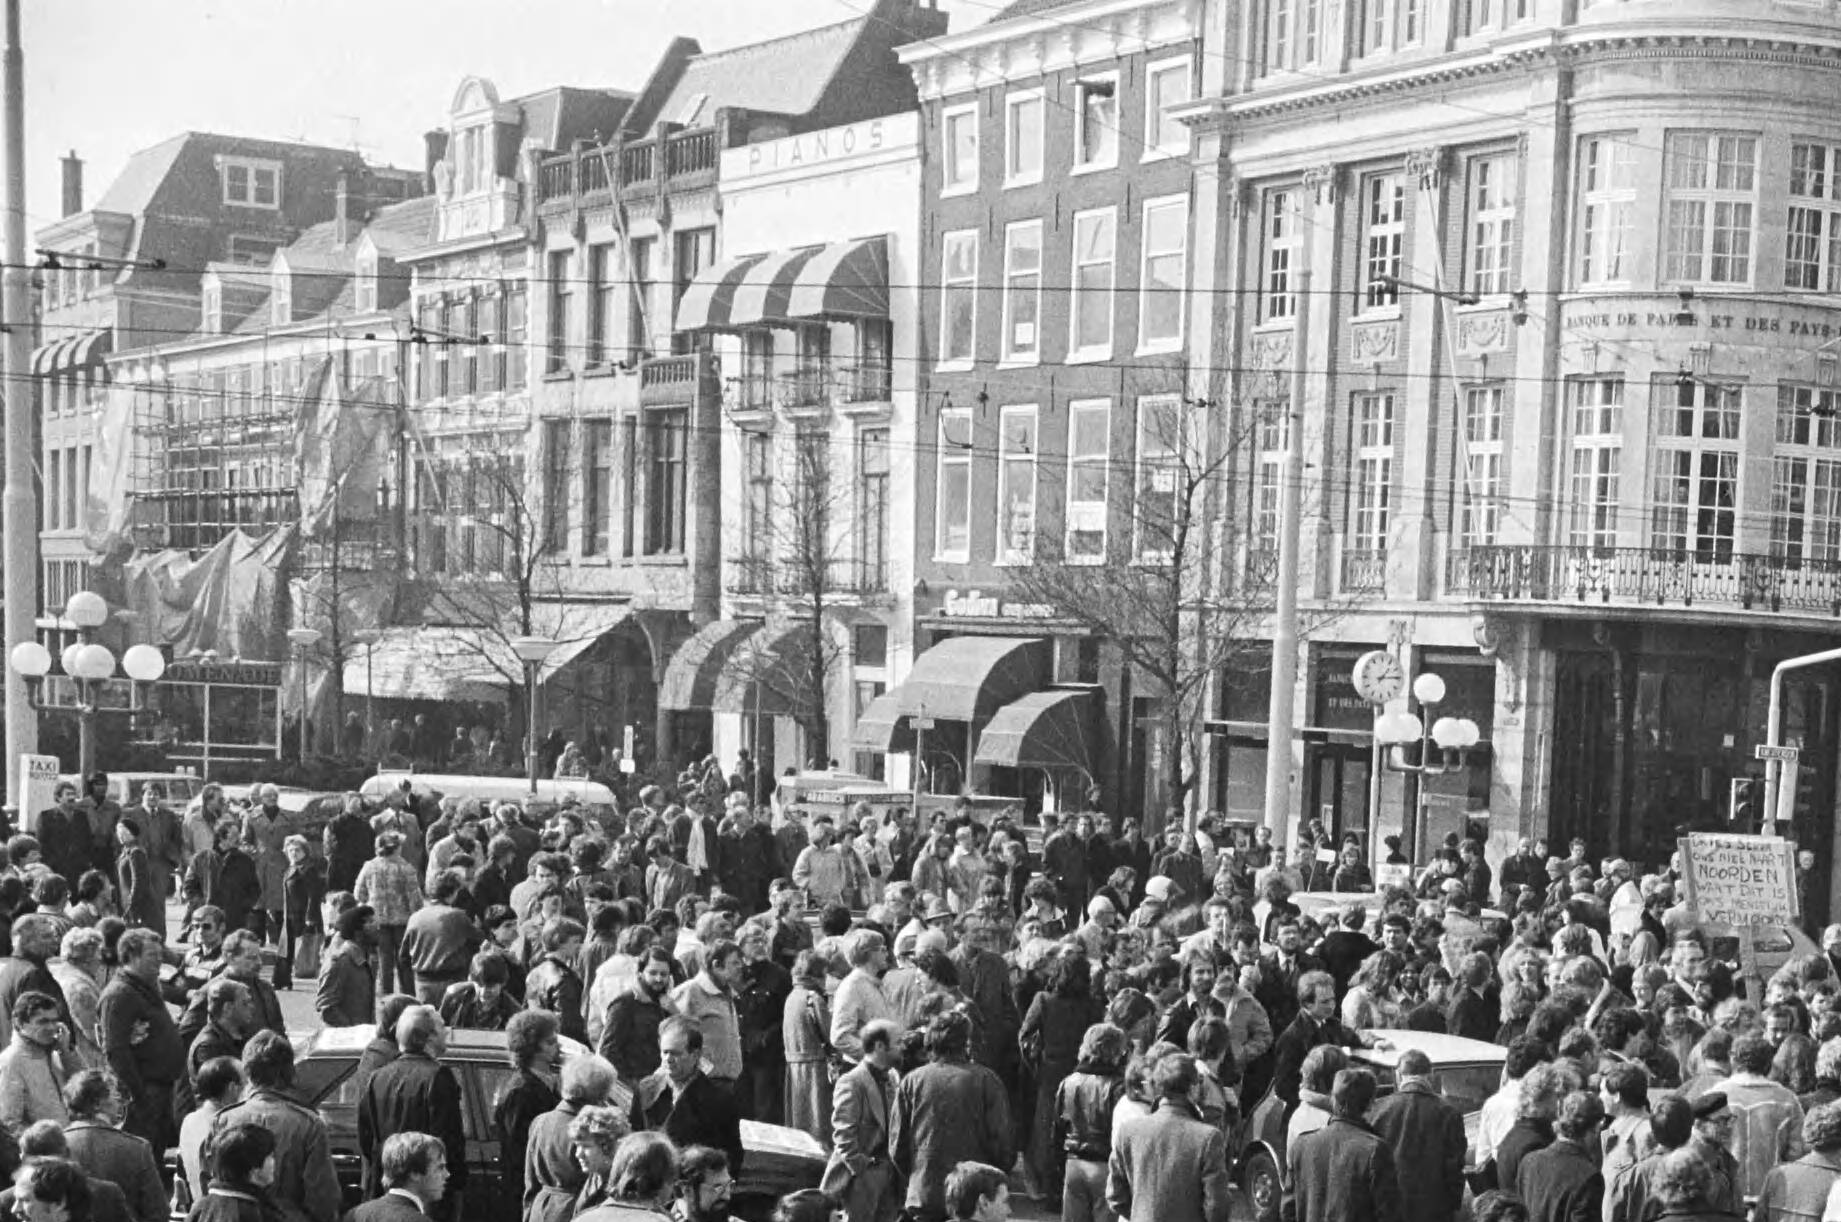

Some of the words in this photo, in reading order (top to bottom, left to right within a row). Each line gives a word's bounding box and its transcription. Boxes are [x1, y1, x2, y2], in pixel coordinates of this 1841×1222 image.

[749, 120, 882, 172] PIANOS
[1567, 313, 1609, 328] BANQUE
[1617, 312, 1637, 327] DE
[1711, 315, 1734, 328] ET
[1745, 317, 1780, 331] DES
[30, 760, 56, 771] TAXI
[1699, 863, 1779, 885] NOORDEN
[1695, 880, 1737, 894] WANT
[1773, 887, 1786, 899] IS
